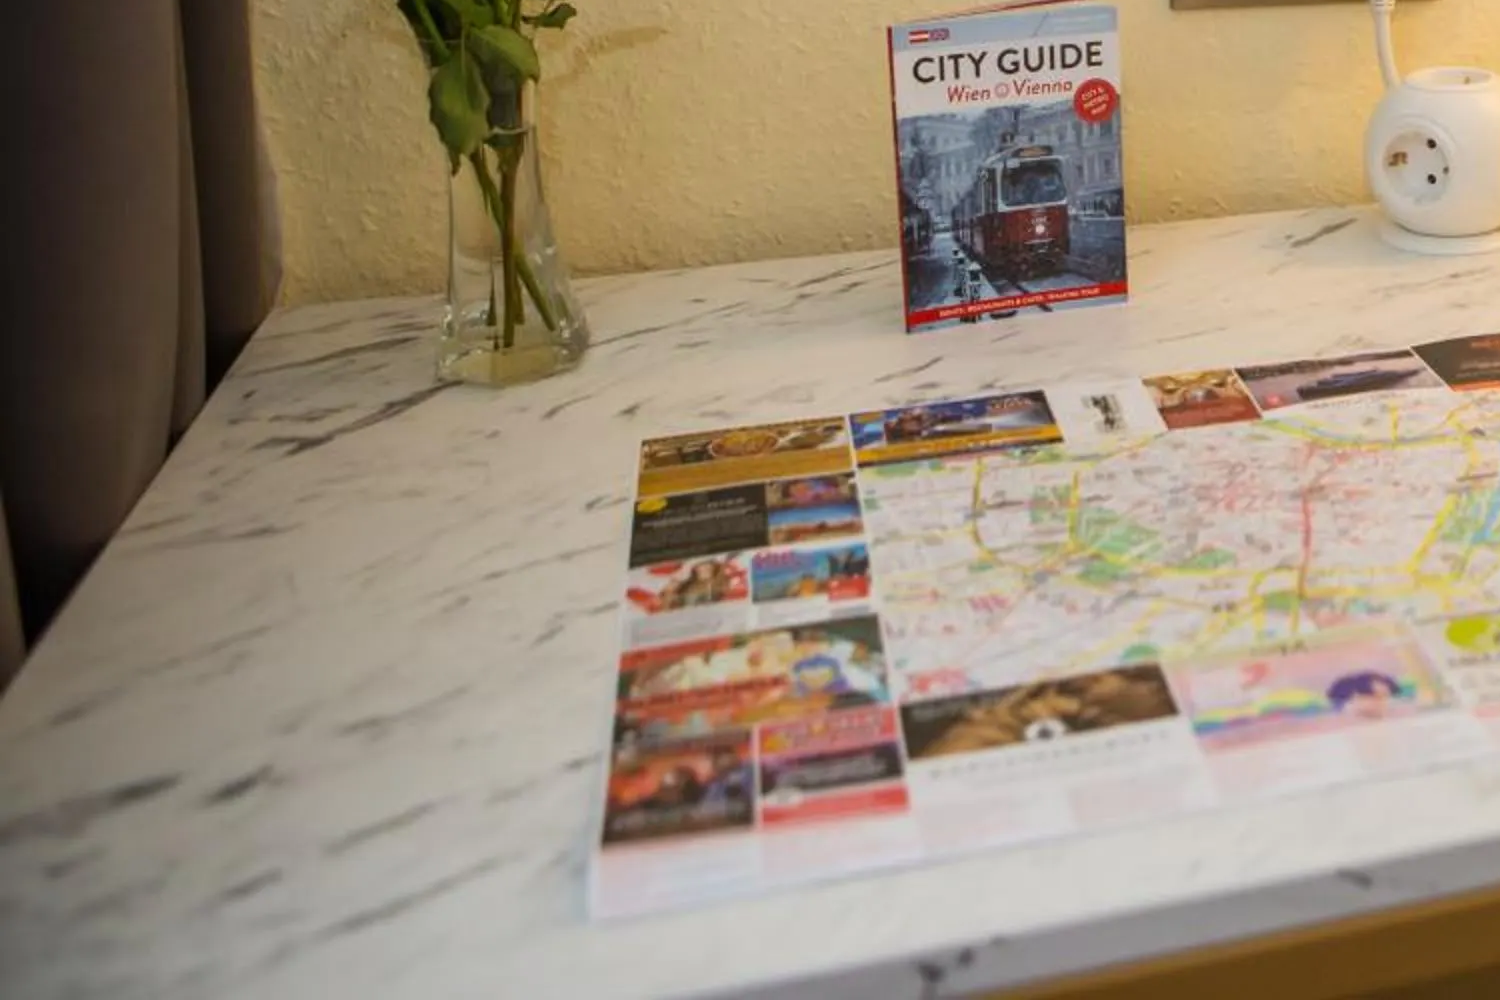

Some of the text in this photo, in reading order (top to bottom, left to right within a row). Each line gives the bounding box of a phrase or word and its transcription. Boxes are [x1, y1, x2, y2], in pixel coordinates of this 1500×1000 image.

[912, 40, 1104, 84] CITY GUIDE
[947, 78, 1073, 103] Wien Vienna
